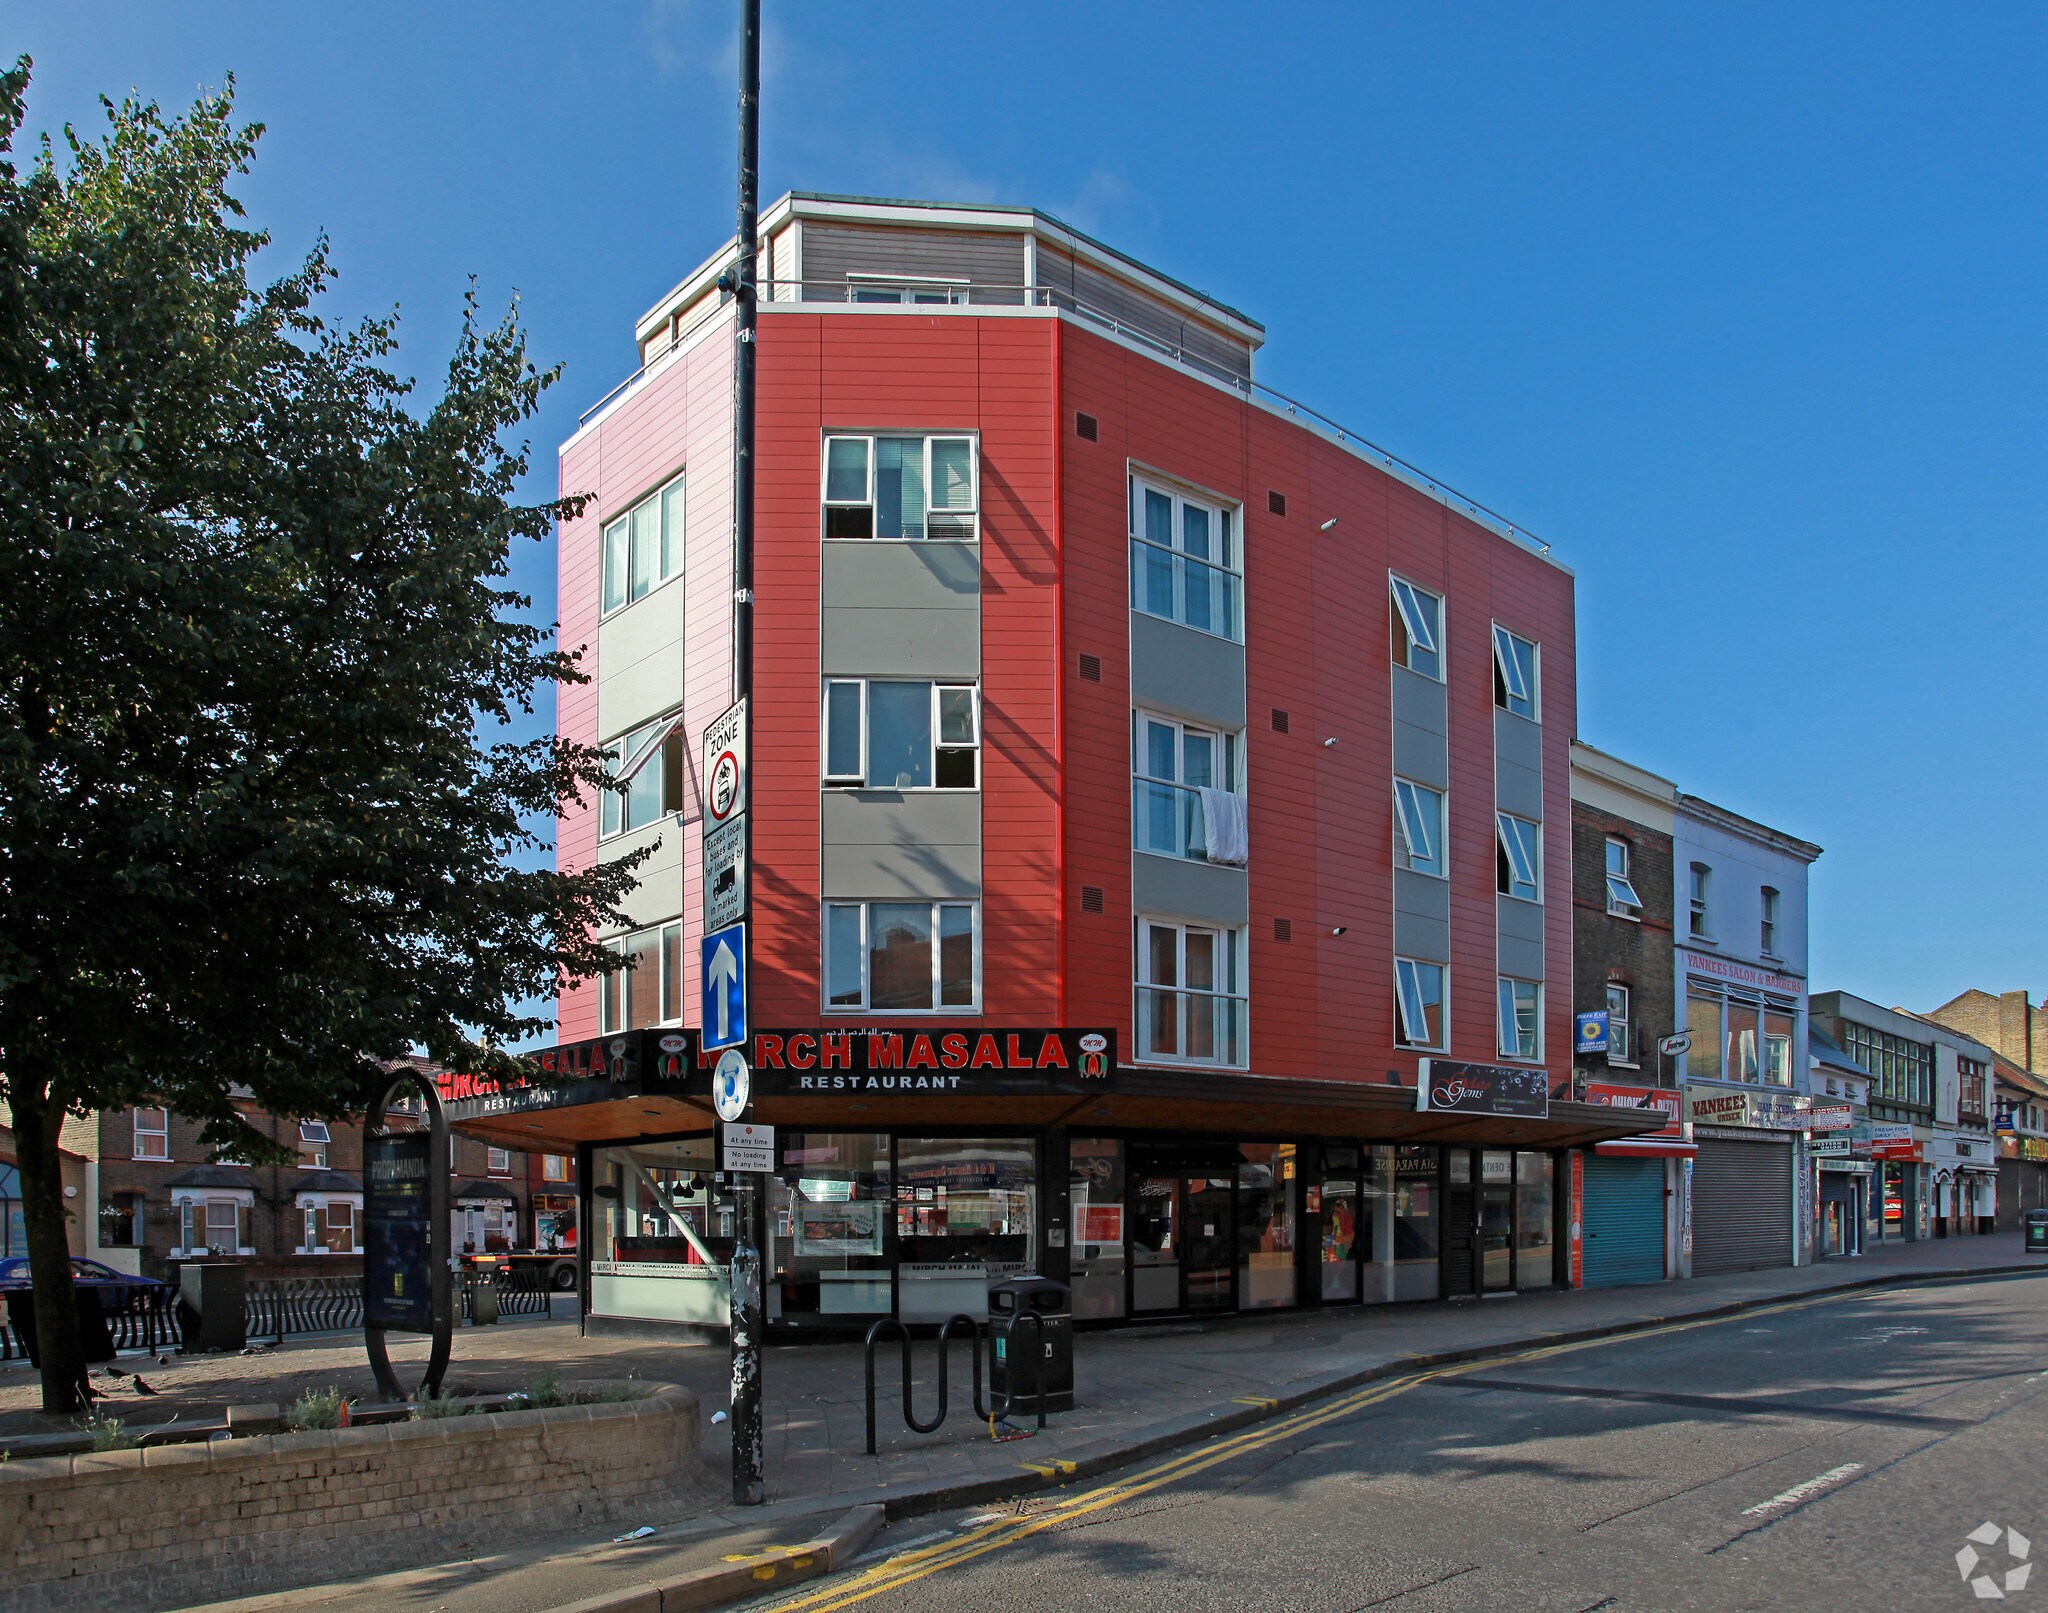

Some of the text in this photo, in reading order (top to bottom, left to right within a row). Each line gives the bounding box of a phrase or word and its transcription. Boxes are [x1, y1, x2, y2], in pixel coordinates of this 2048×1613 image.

[706, 702, 744, 744] PEDESTRIAN
[711, 721, 738, 757] ZONE
[706, 819, 742, 851] Except local
[709, 835, 739, 862] buses and
[705, 847, 744, 879] for loading by
[710, 892, 738, 916] in marked
[710, 906, 739, 930] areas only
[1687, 953, 1801, 993] YANKEES SALON & BARBERS
[868, 1033, 1069, 1069] MASALA
[801, 1076, 961, 1088] RESTAURANT
[484, 1090, 559, 1111] RESTAURANT
[1692, 1094, 1746, 1116] YANKEES
[1717, 1111, 1741, 1122] UNISEX
[754, 1137, 768, 1145] time
[1693, 1127, 1790, 1140] www.yankeessalon.com
[743, 1151, 766, 1160] loading
